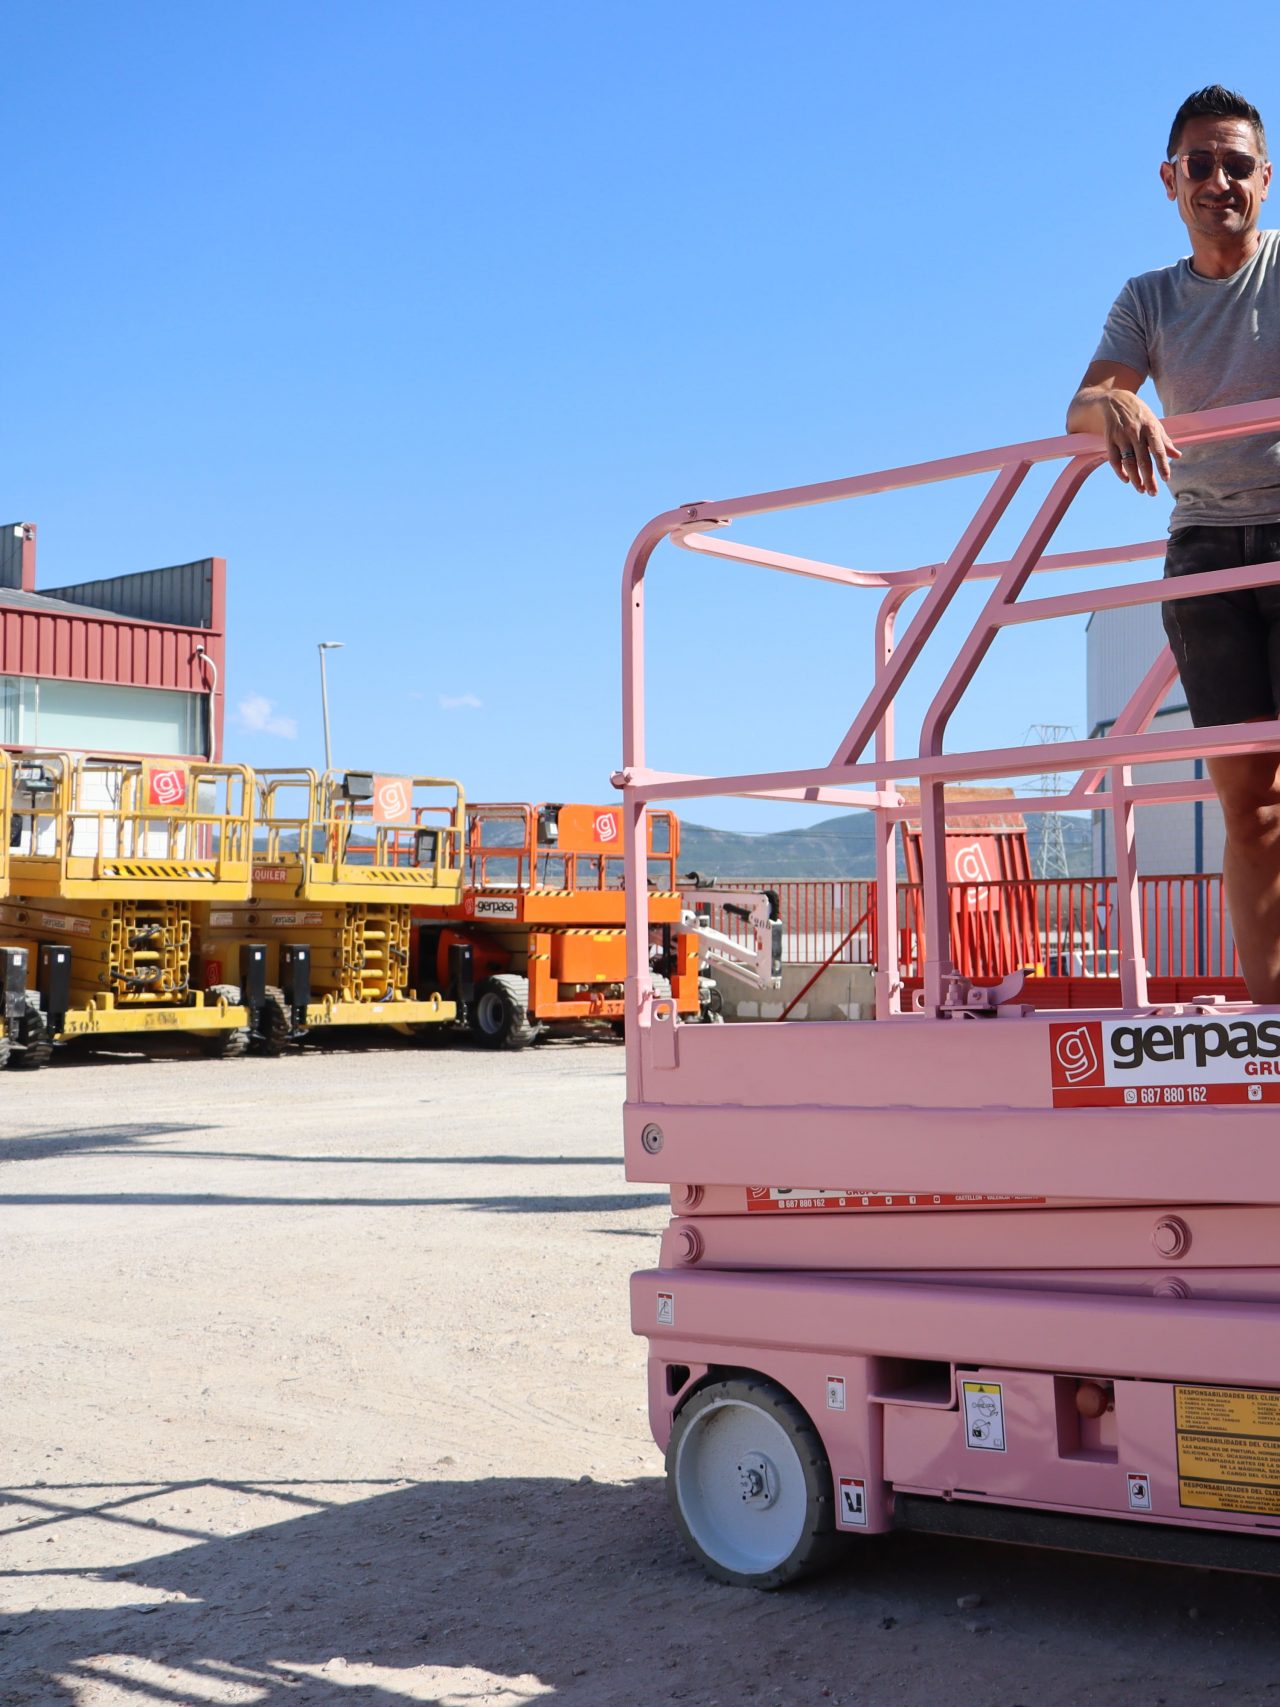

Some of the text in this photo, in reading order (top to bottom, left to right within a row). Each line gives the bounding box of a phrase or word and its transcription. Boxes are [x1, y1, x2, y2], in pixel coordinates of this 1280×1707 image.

[252, 869, 286, 881] QUILER
[477, 901, 514, 914] gerpasa
[1140, 1086, 1207, 1104] 687 880 162
[786, 1199, 798, 1208] 687
[813, 1199, 825, 1207] 162
[1179, 1389, 1245, 1400] RESPONSABILIDADES
[1181, 1435, 1247, 1447] RESPONSABILIDADES
[1183, 1481, 1249, 1494] RESPONSABILIDADES
